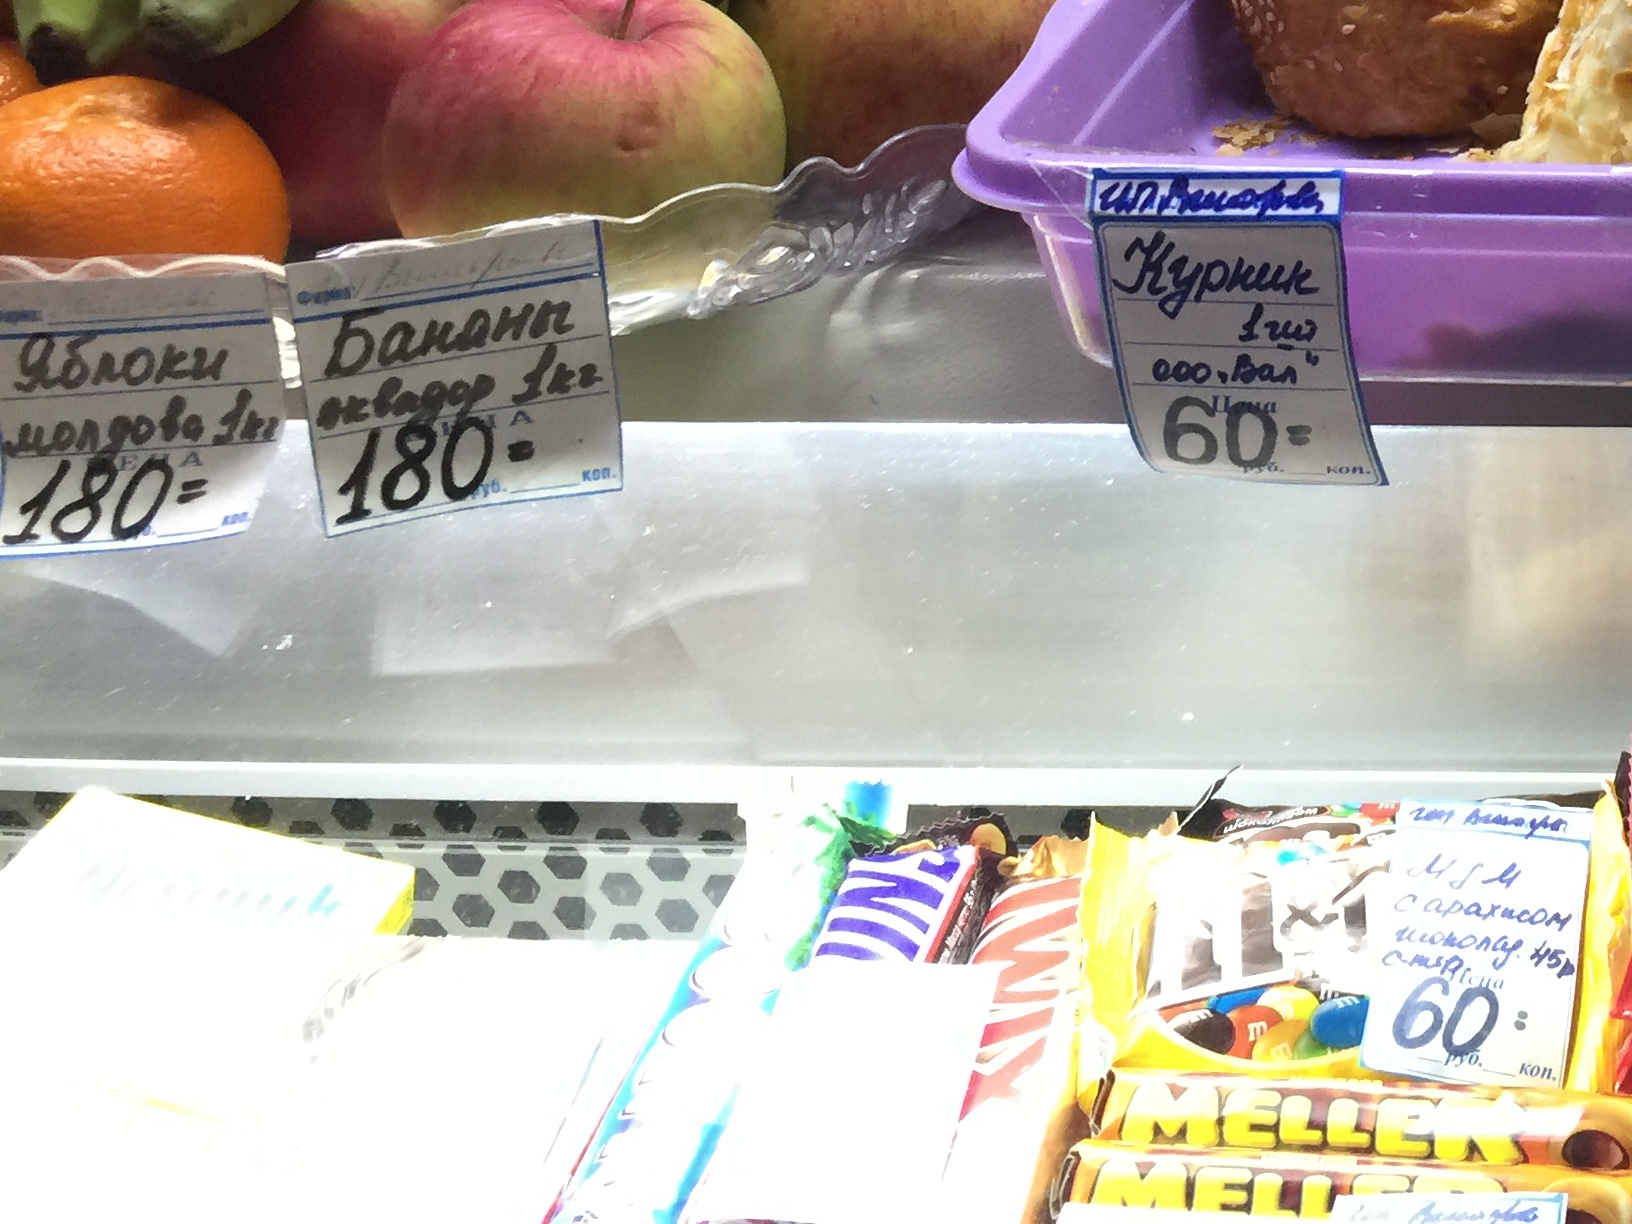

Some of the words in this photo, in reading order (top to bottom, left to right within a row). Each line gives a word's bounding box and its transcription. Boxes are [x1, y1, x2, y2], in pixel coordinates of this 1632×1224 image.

[1112, 230, 1320, 320] Курник
[14, 331, 229, 393] Яблоки
[324, 299, 576, 378] Бананы
[1518, 1061, 1557, 1082] коп.
[1120, 1081, 1527, 1165] MELLER
